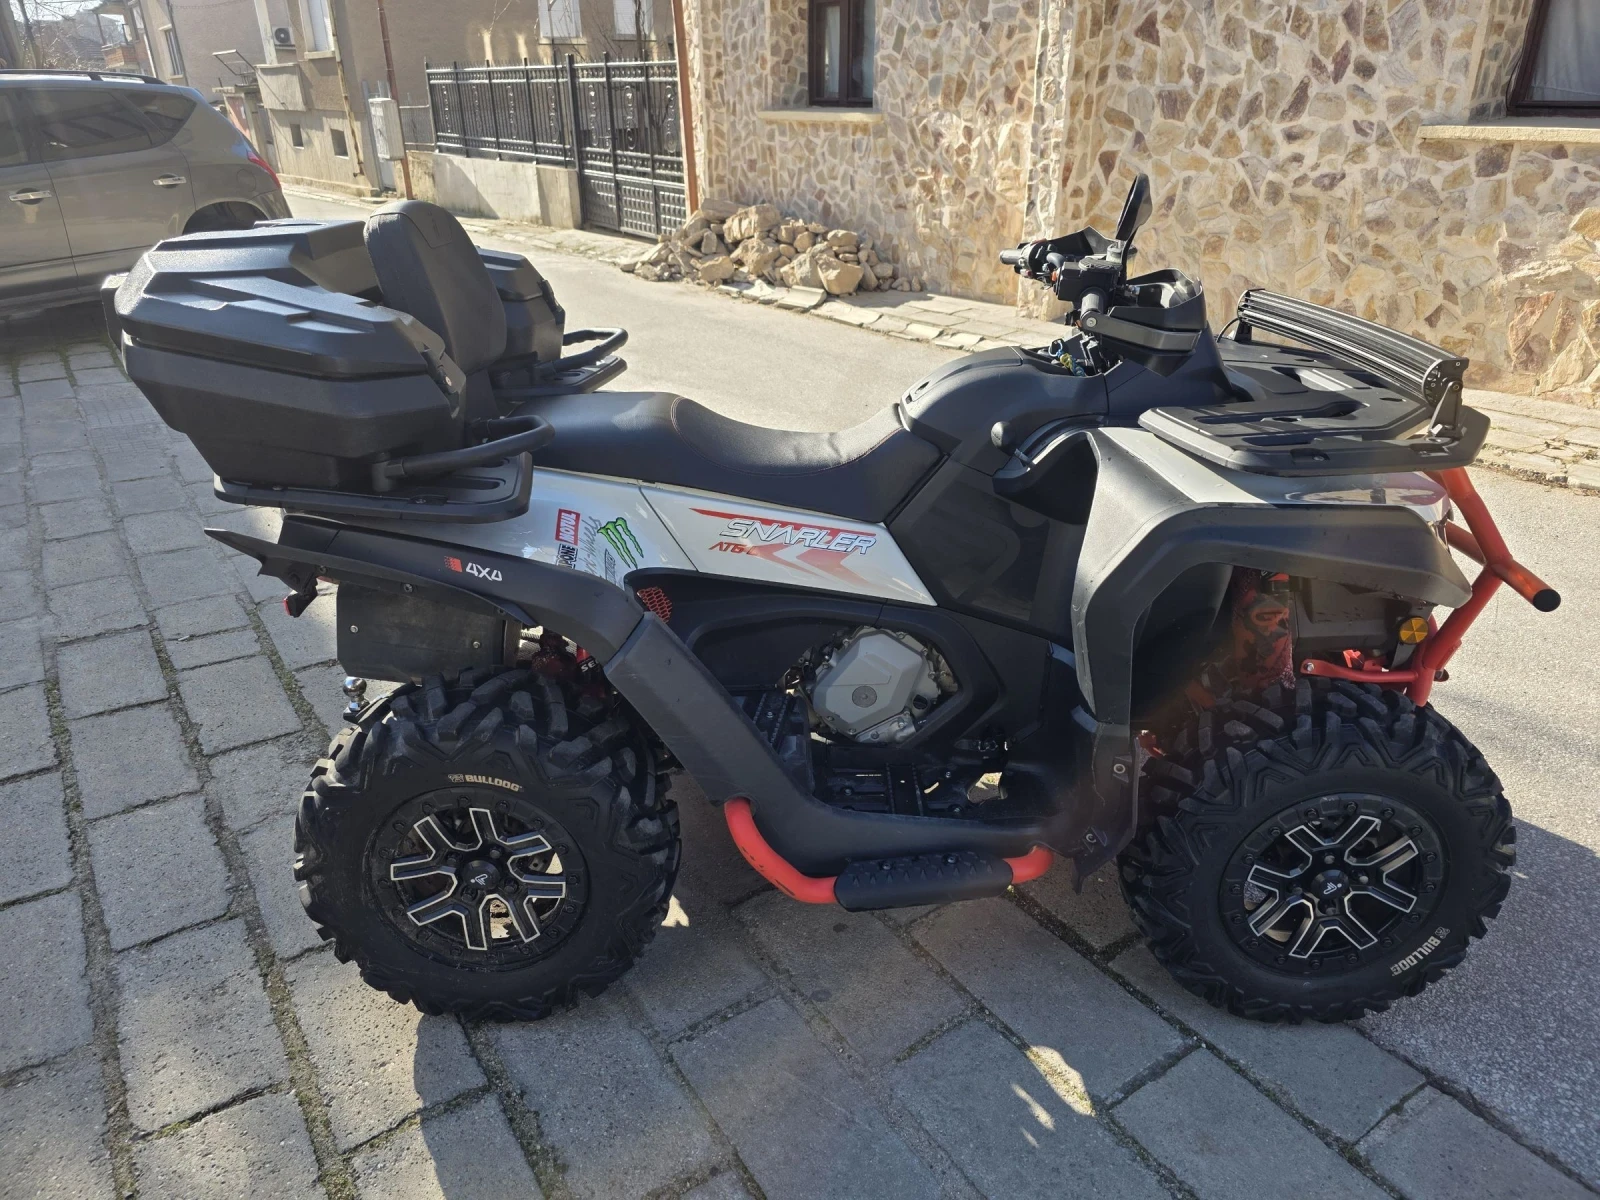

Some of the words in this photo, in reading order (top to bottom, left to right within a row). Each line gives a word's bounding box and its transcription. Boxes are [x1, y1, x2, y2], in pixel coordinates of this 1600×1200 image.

[558, 512, 576, 544] MOTUL
[719, 518, 877, 555] SNARLER
[464, 774, 520, 792] BULLDOG
[1390, 935, 1441, 976] BULLDOG
